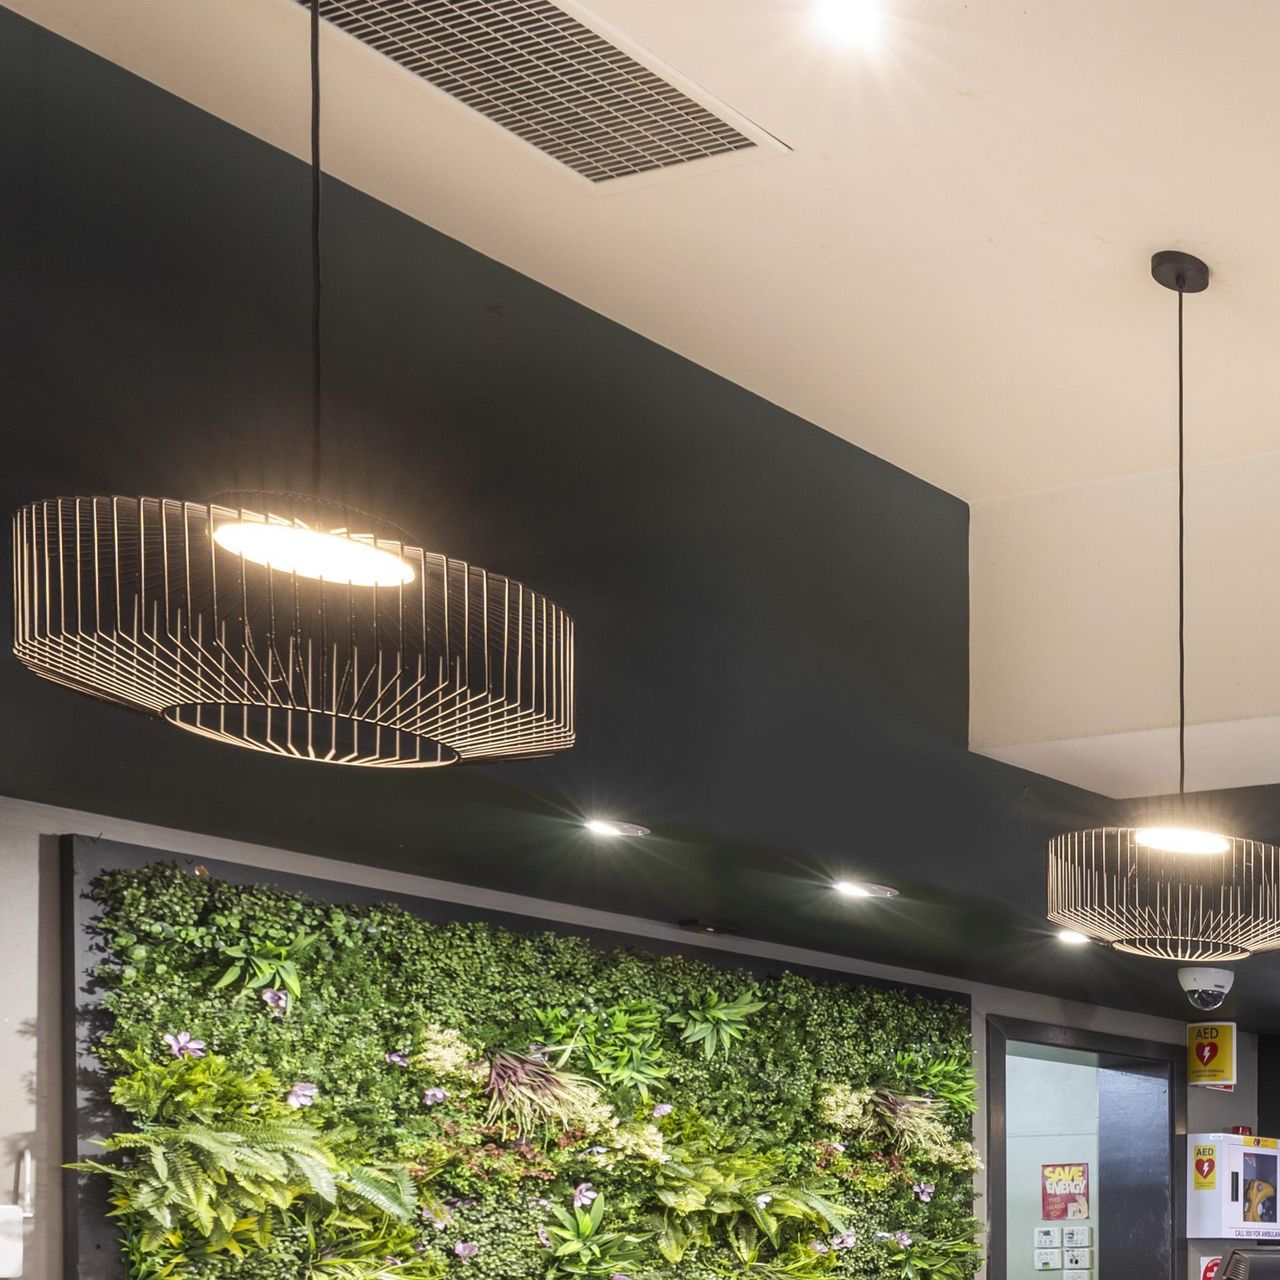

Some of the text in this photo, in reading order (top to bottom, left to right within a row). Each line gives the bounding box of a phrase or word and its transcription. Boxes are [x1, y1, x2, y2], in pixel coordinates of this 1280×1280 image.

[1196, 1028, 1219, 1040] AED
[1196, 1148, 1214, 1156] AED
[1044, 1166, 1084, 1182] SAVE
[1045, 1180, 1086, 1194] ENERGY
